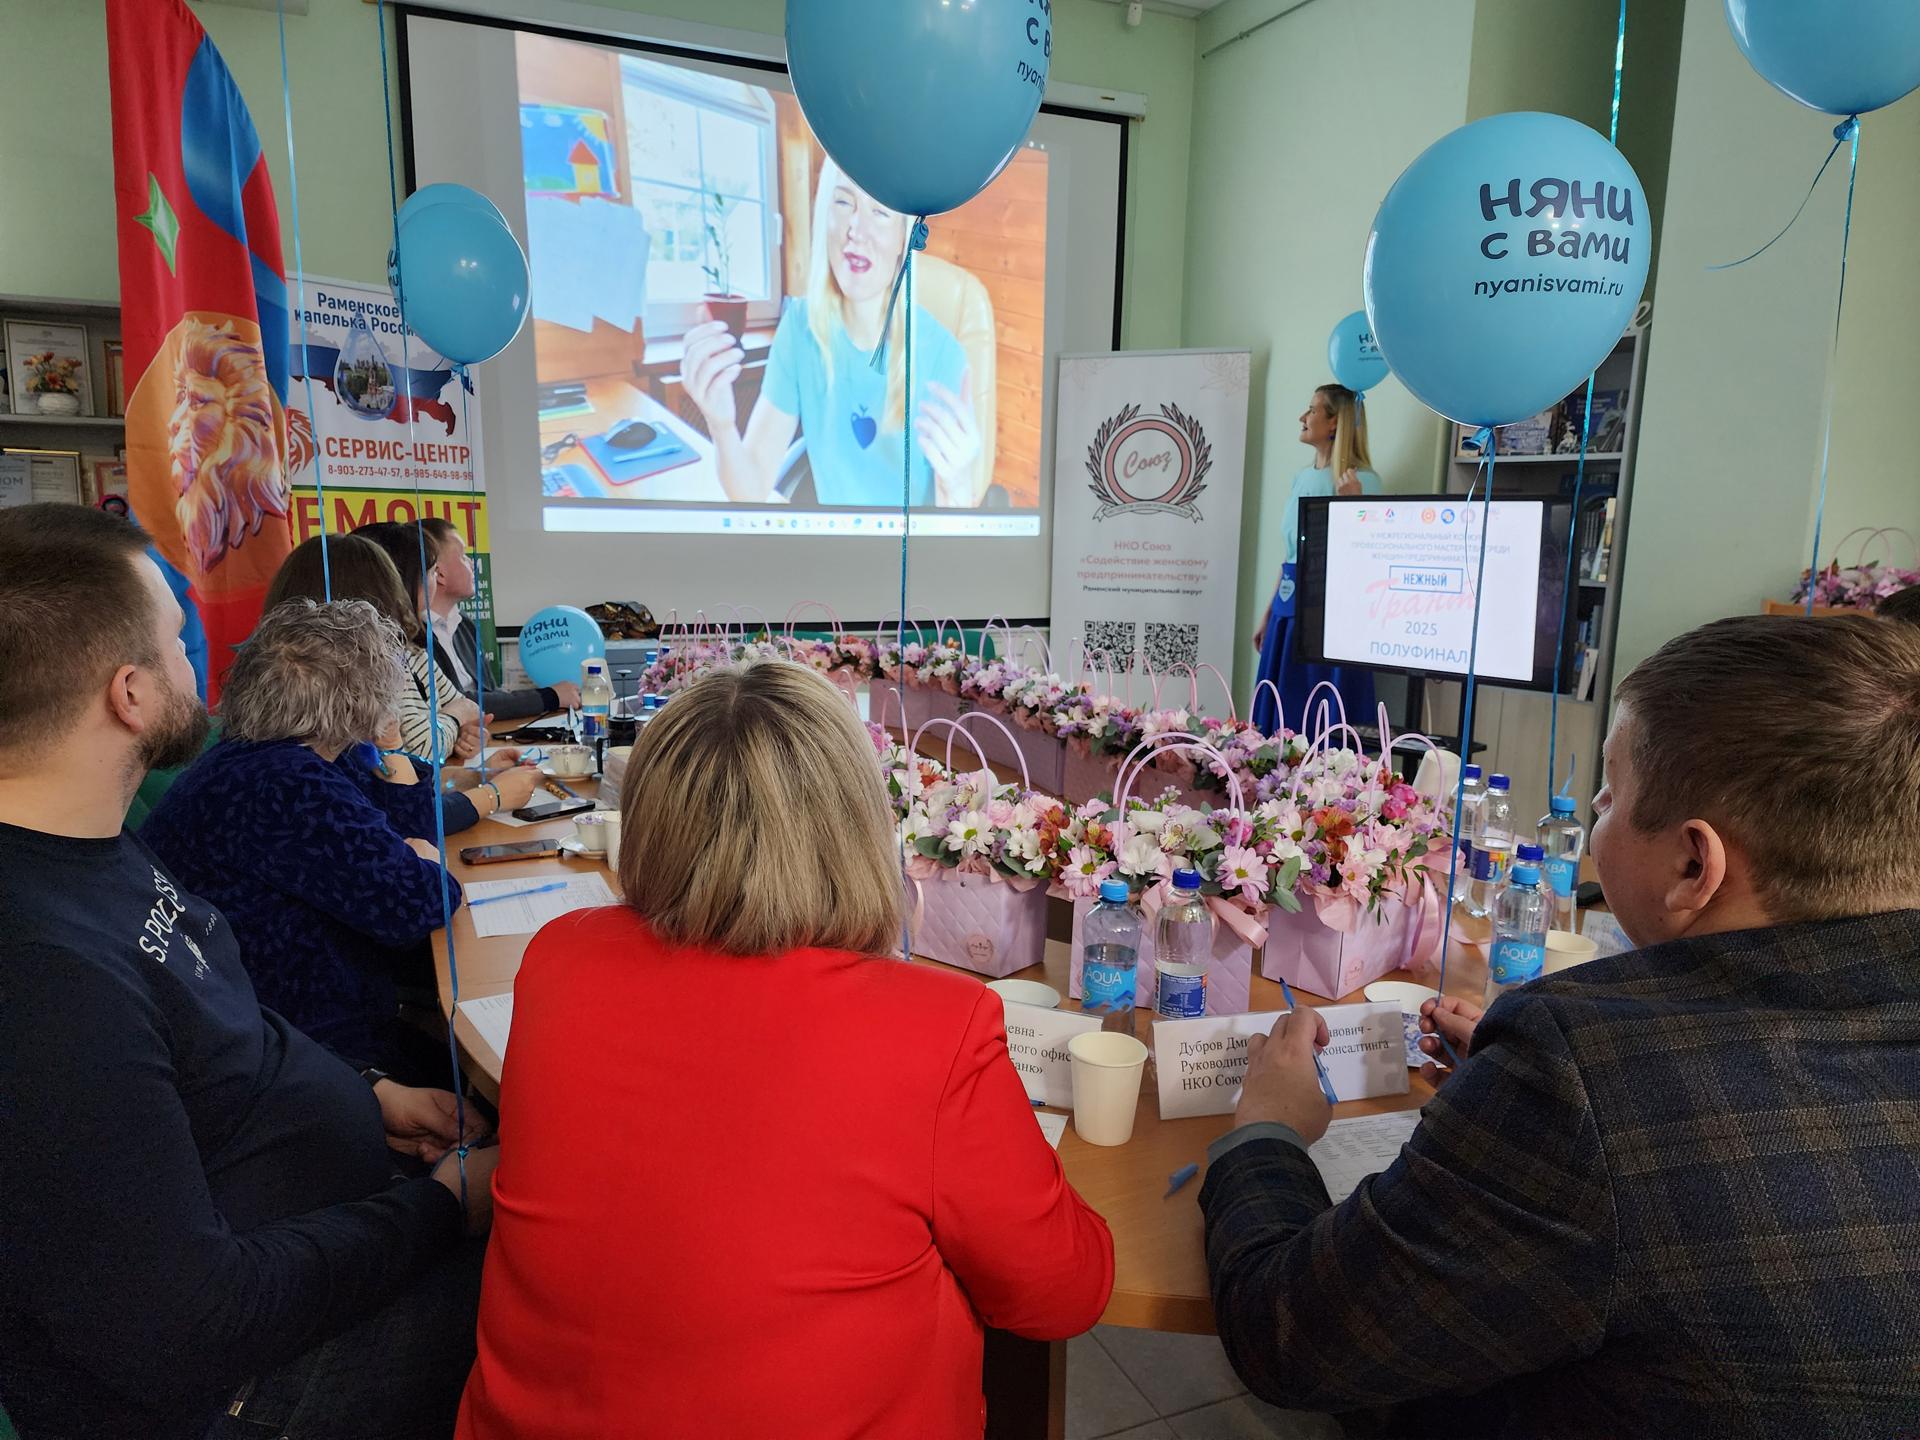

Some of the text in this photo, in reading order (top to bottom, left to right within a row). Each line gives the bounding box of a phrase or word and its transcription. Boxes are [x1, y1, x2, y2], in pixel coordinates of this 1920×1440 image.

[1474, 273, 1624, 299] nyanisvami.ru
[316, 291, 400, 319] Раменское
[294, 308, 415, 337] капелька Росси
[325, 436, 470, 466] СЕРВИС-ЦЕНТР
[1123, 449, 1172, 479] Союз
[1113, 540, 1172, 552] НКО Союз
[1080, 554, 1209, 569] «Содействие женскому
[1077, 570, 1208, 584] предпринимательству»
[1403, 572, 1448, 587] НЕЖНЫЙ
[1404, 620, 1438, 636] 2025
[1369, 641, 1468, 665] ПОЛУФИНАЛ
[1499, 944, 1538, 962] AQUA
[1085, 966, 1123, 987] AQUA
[1178, 1040, 1224, 1057] Дубров
[1321, 1039, 1390, 1057] консалтинга
[1012, 1058, 1043, 1074] анк»
[1181, 1073, 1244, 1091] НКО Сою
